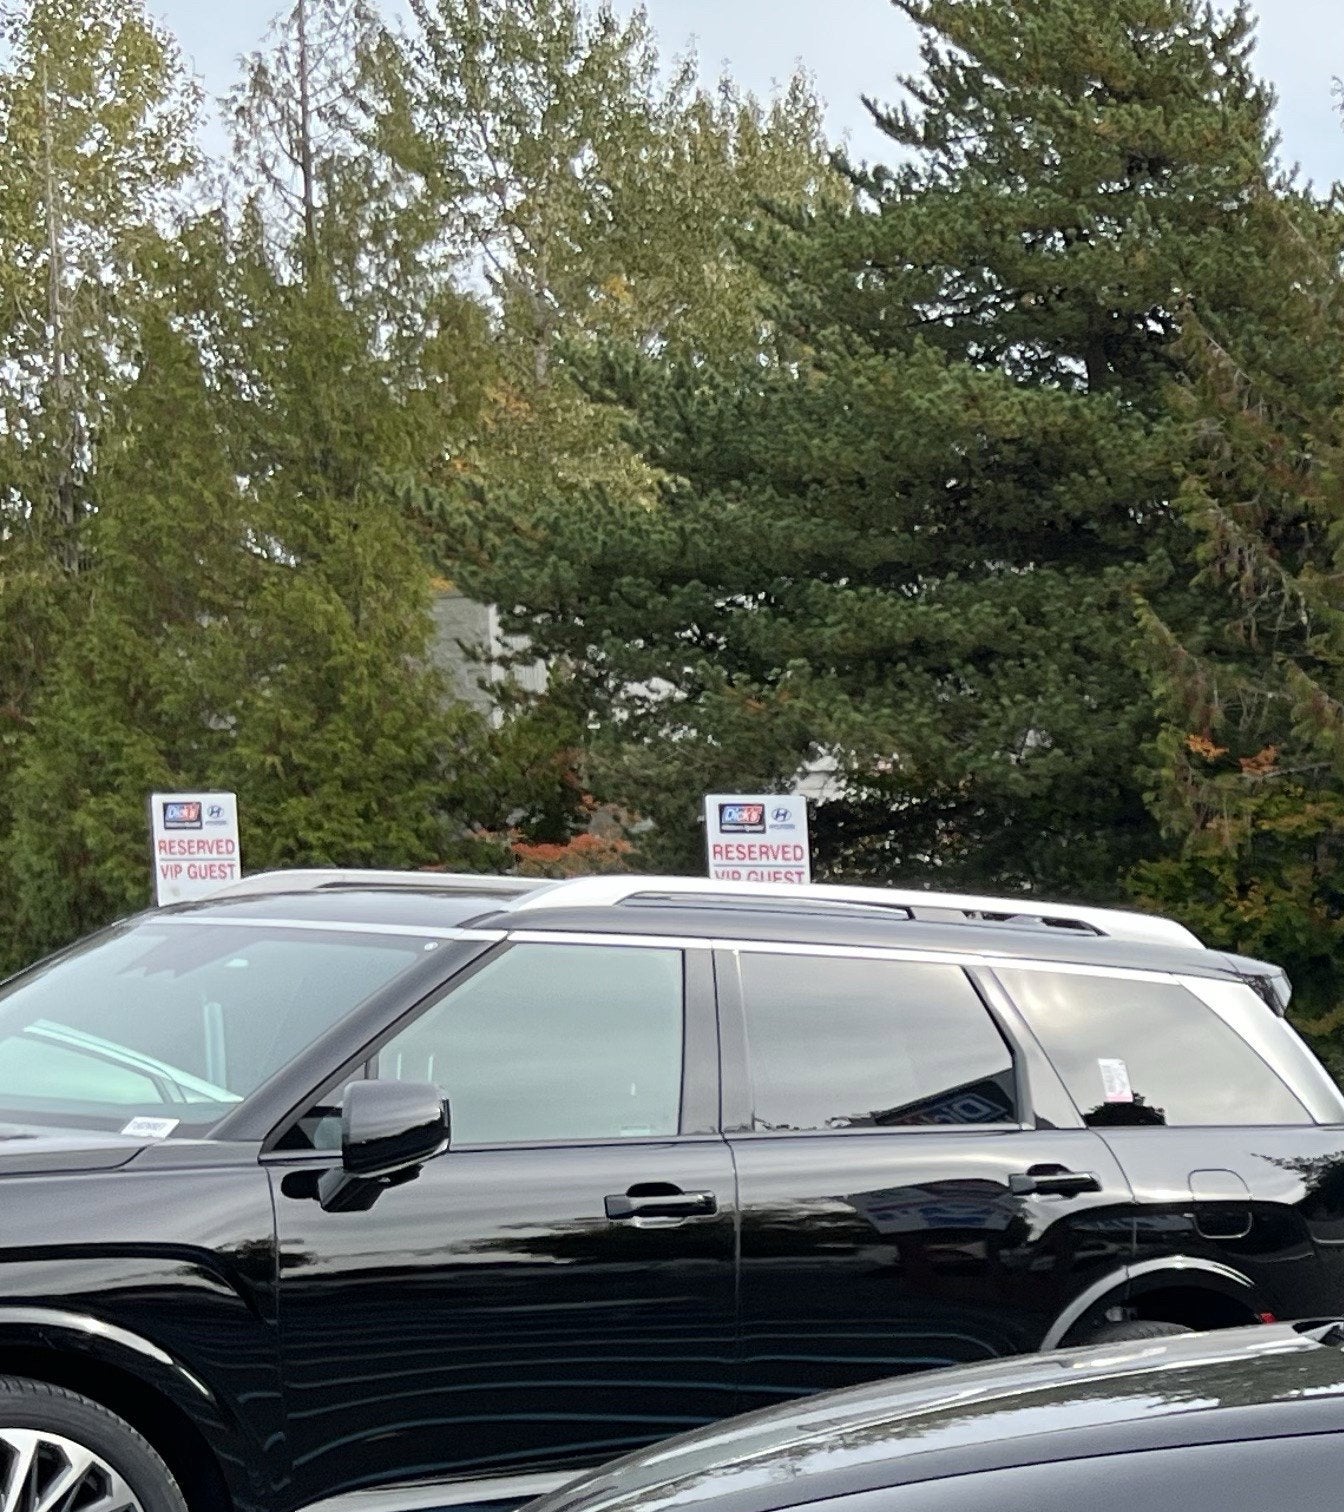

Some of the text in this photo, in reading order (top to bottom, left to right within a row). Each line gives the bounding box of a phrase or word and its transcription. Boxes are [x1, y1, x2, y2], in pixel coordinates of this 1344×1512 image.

[158, 839, 236, 855] RESERVED
[712, 844, 804, 861] RESERVED
[160, 864, 236, 880] VIP GUEST
